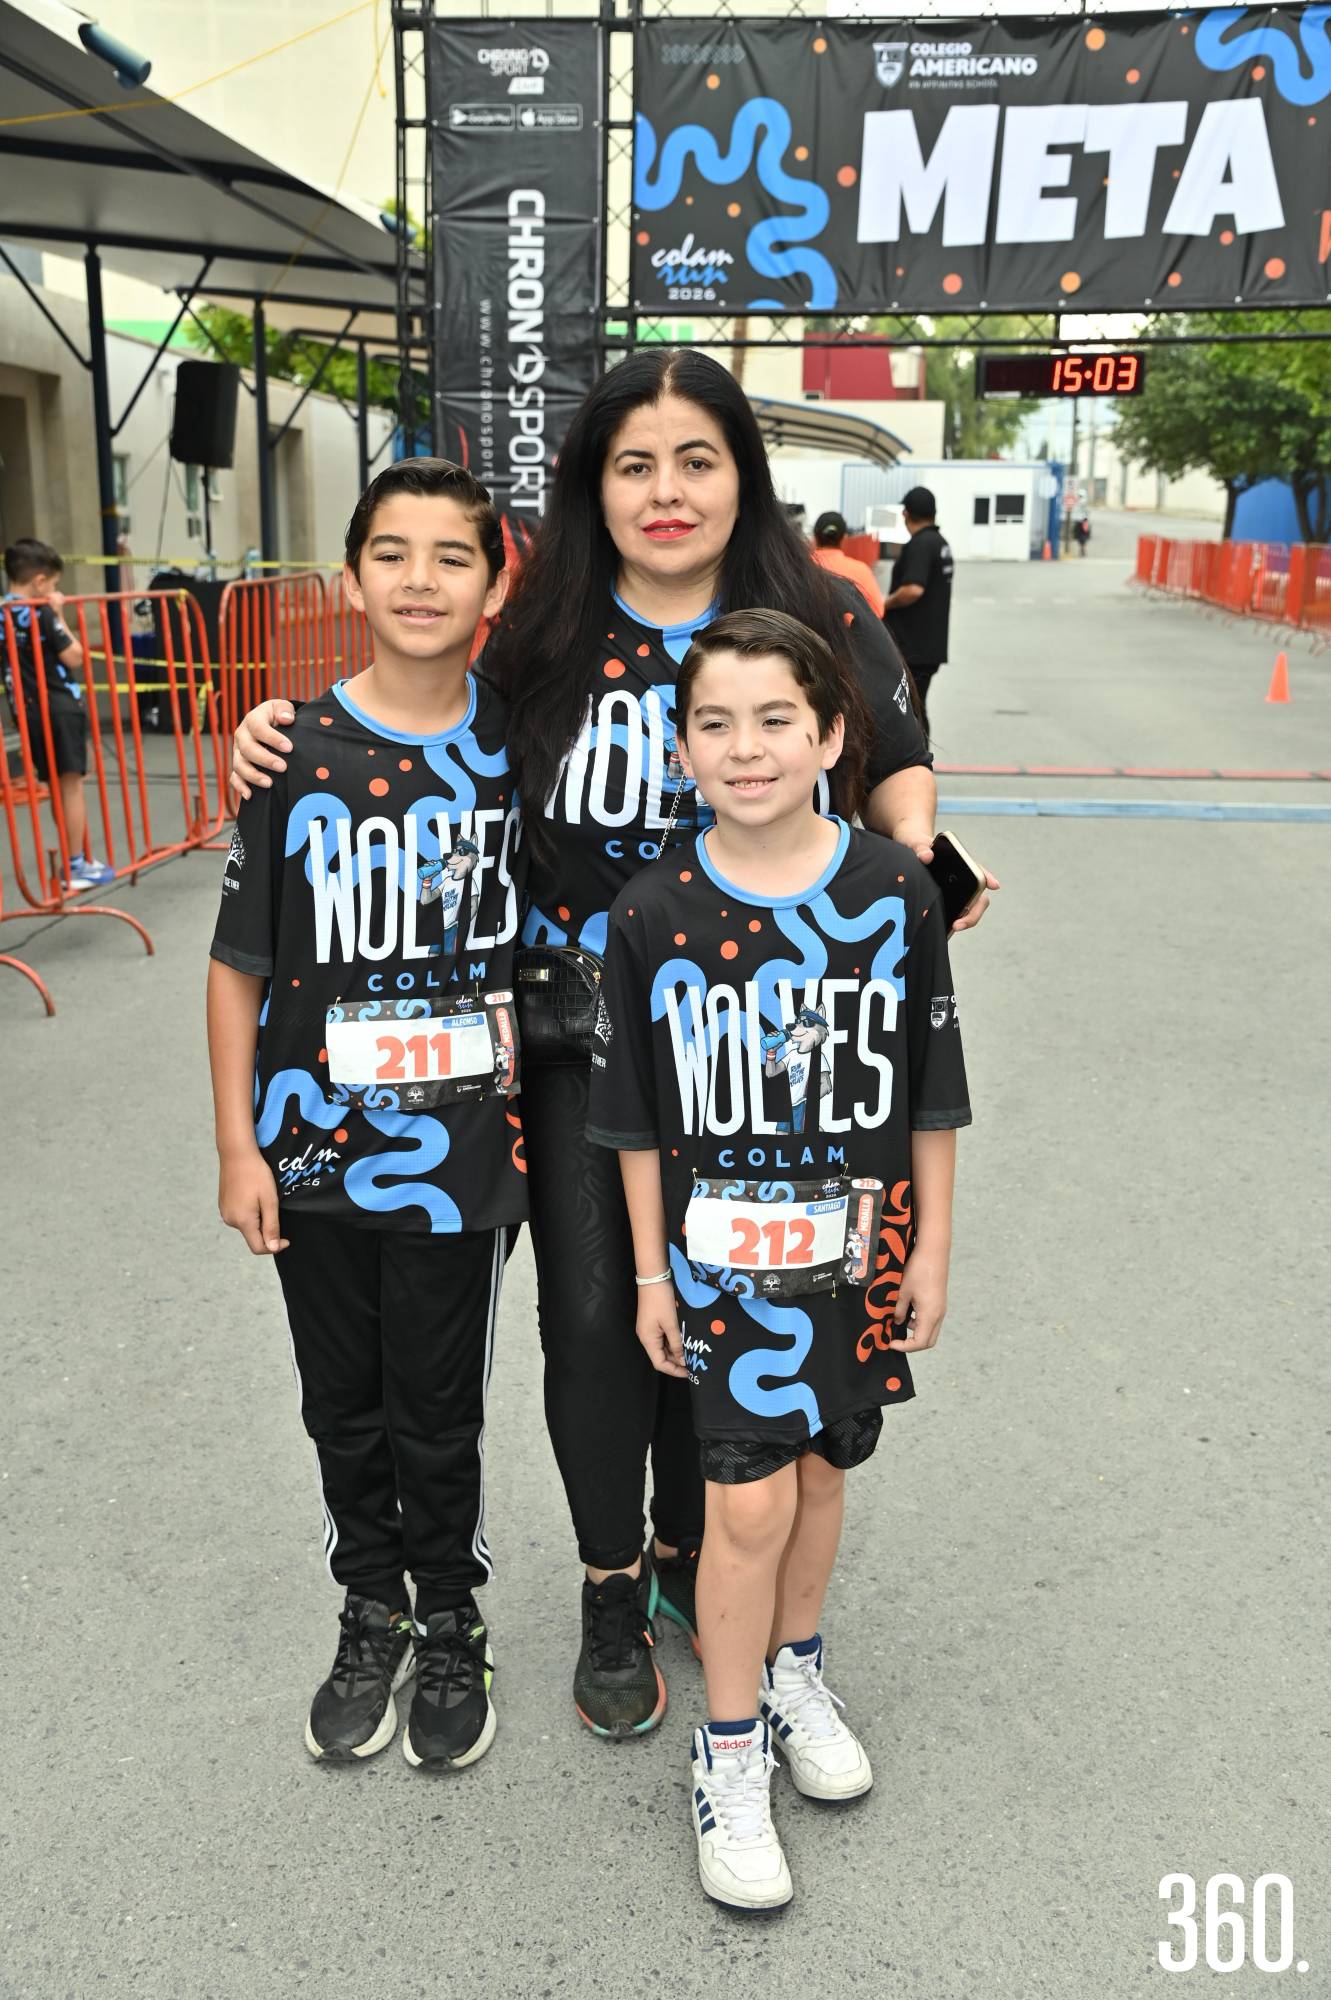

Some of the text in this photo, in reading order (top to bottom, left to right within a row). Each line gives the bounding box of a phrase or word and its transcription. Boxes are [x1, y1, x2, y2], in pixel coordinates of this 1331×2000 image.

[910, 42, 972, 56] COLEGIO
[909, 57, 1038, 77] AMERICANO
[537, 113, 578, 126] App Store
[857, 97, 1286, 247] META
[651, 232, 734, 268] colam
[668, 287, 716, 301] 2026
[367, 961, 487, 993] COLAM
[451, 1017, 478, 1027] ALFONSO
[376, 1033, 451, 1080] 211
[663, 978, 898, 1138] WOLVES
[718, 1146, 845, 1168] COLAM
[859, 1179, 876, 1188] 212
[814, 1201, 841, 1212] SANTIAGO
[860, 1199, 871, 1232] MEDALLA
[728, 1218, 816, 1266] 212
[712, 1738, 753, 1751] adidas
